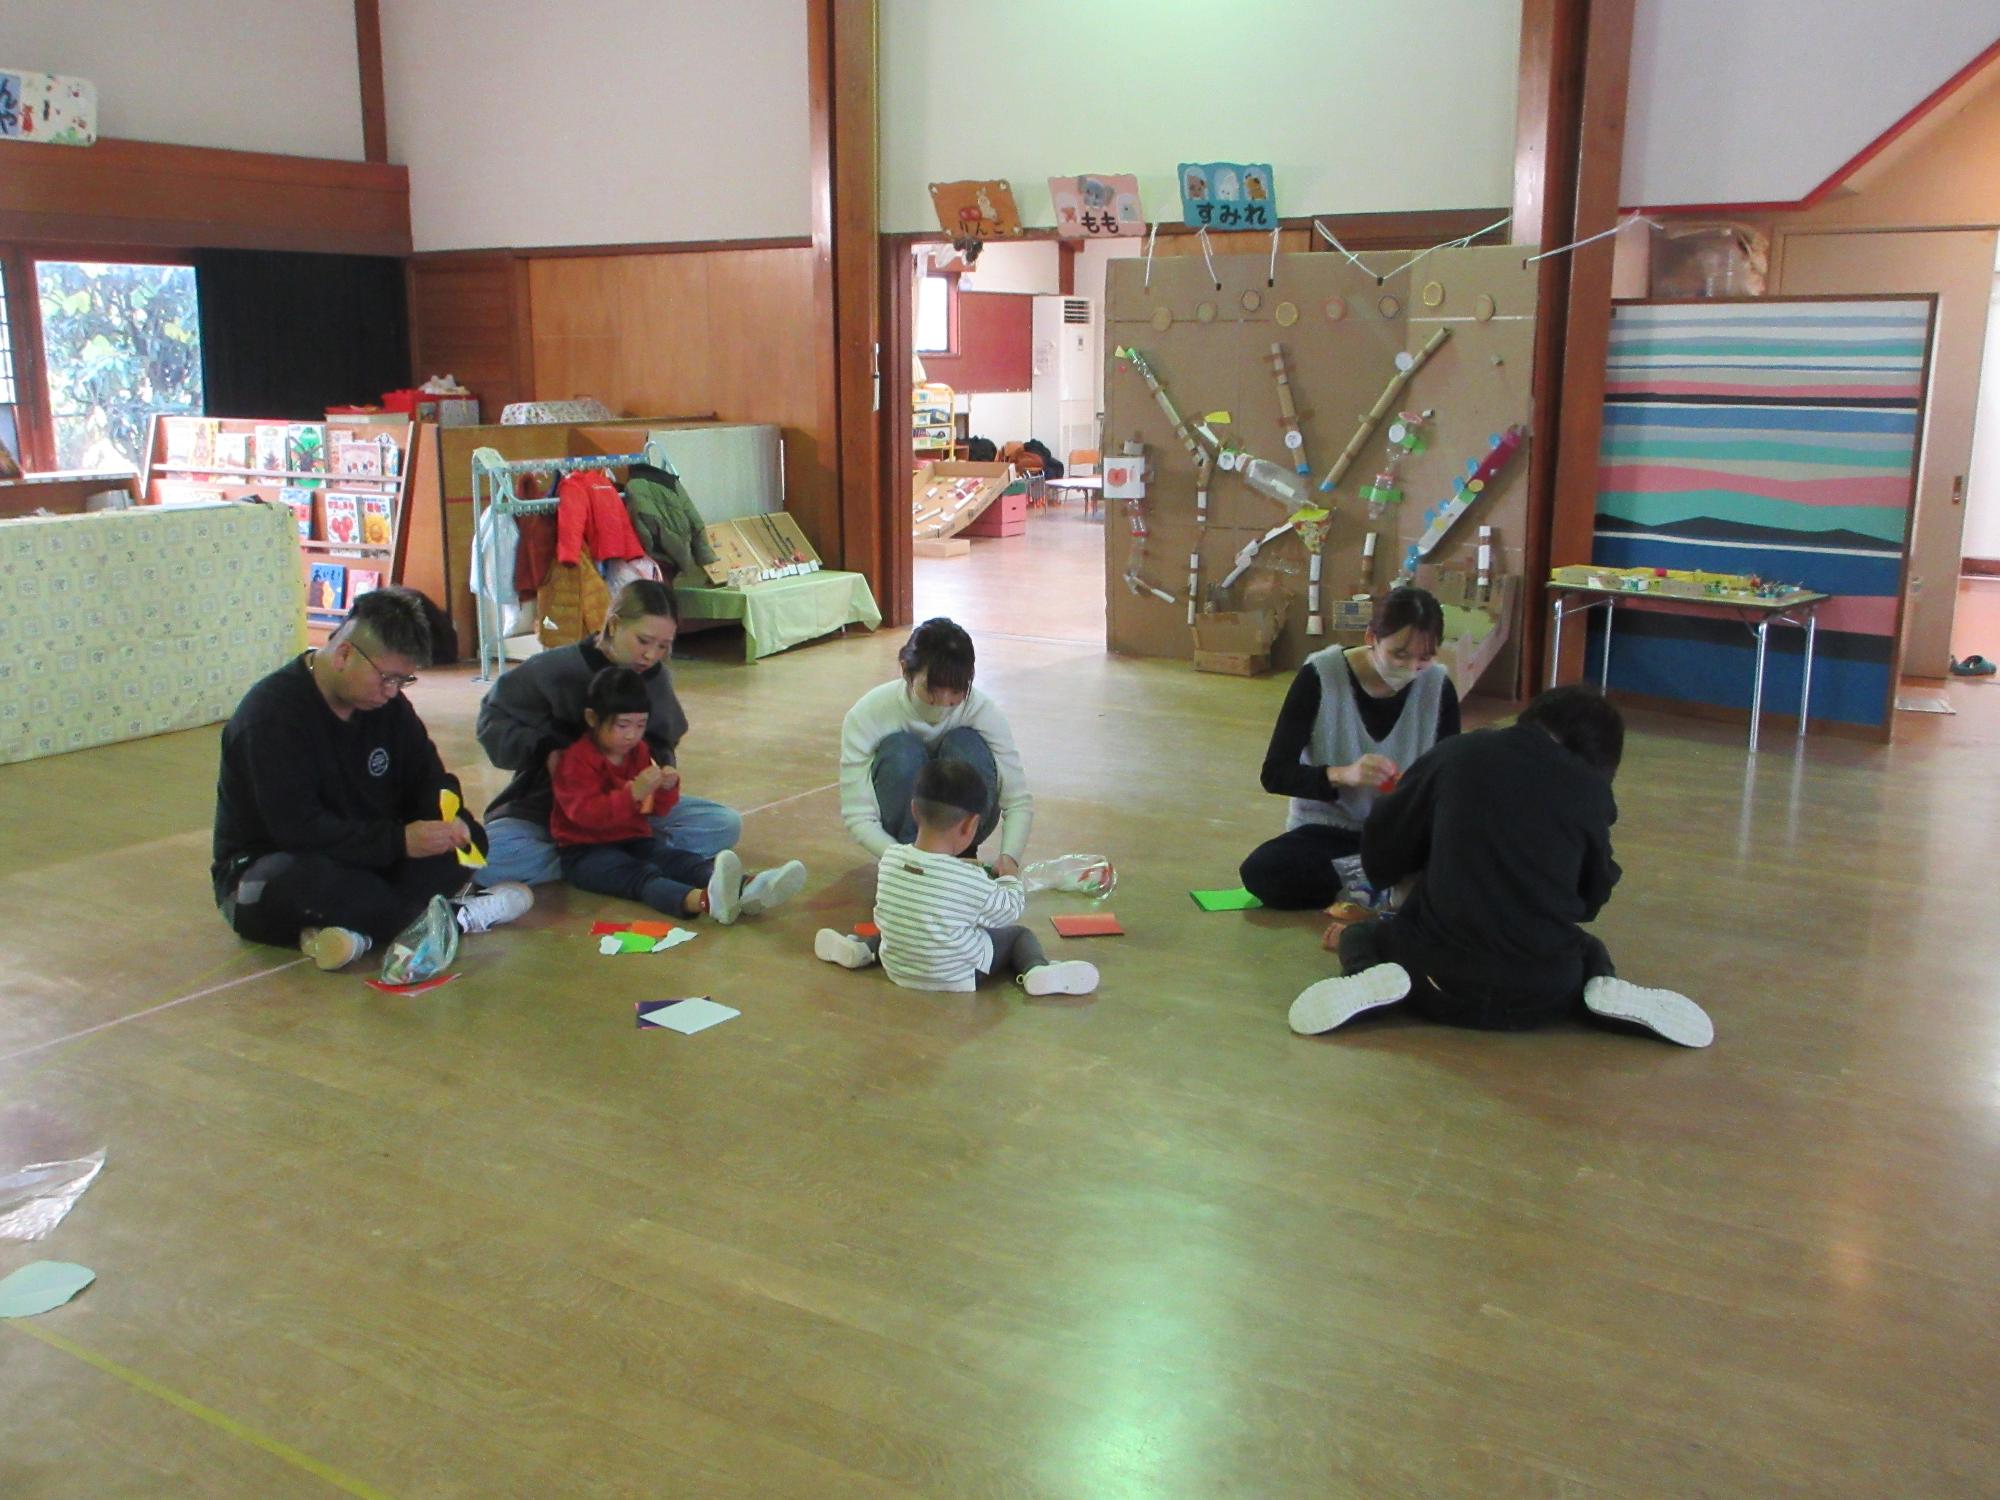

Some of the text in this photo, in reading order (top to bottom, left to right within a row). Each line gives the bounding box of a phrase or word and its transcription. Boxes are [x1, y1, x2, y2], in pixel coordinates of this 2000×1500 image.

[1081, 211, 1119, 234] もも
[1196, 203, 1267, 225] すみれ
